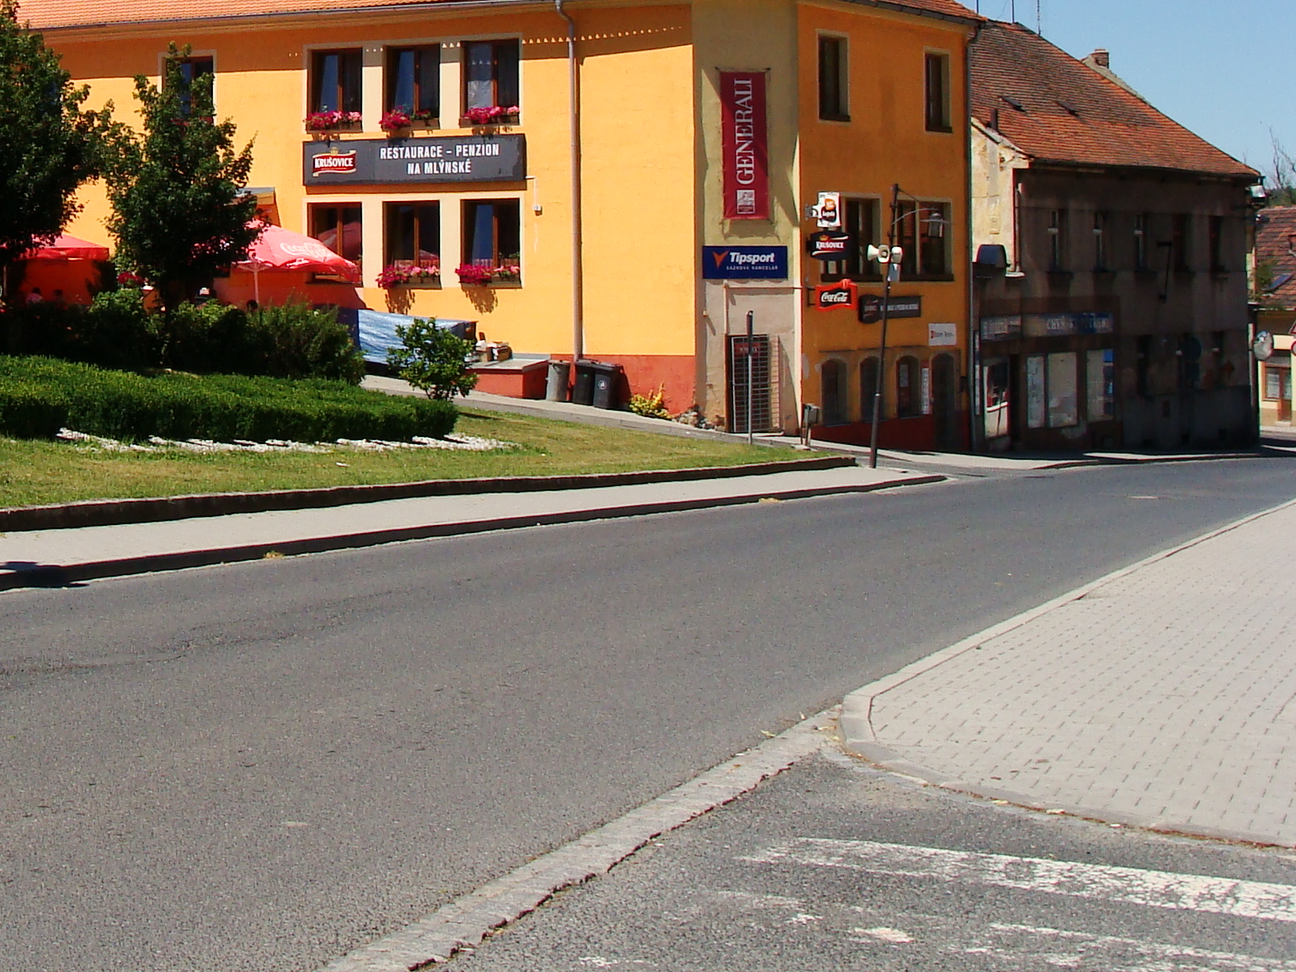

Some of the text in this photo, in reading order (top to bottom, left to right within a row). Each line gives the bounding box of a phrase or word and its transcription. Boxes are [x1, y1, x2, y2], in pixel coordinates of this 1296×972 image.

[734, 78, 755, 185] GENERALI
[380, 145, 443, 160] RESTAURACE
[456, 143, 500, 157] PENZION
[314, 156, 354, 168] KRUŠOVICE
[407, 159, 472, 175] NA MLÝNSKÉ
[729, 251, 775, 265] Tipsport
